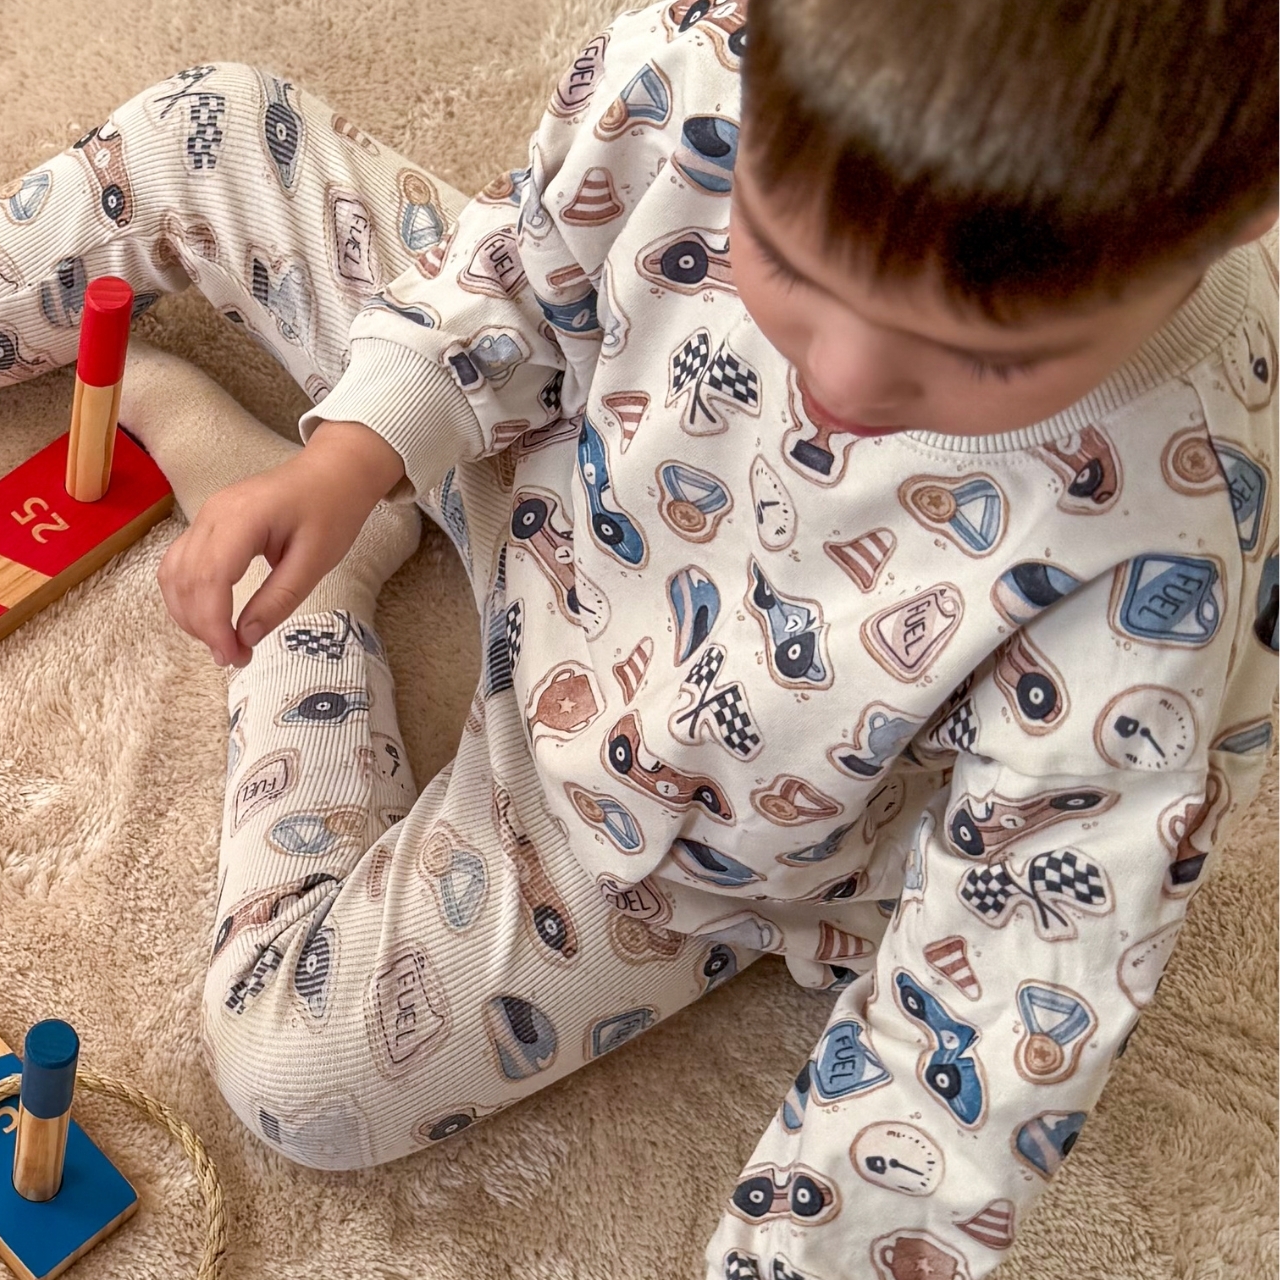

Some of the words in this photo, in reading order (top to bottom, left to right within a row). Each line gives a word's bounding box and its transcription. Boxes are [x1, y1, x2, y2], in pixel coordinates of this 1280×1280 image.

[569, 45, 599, 96] FUEL
[343, 212, 368, 266] FUEL
[484, 237, 515, 283] FUEL
[10, 496, 70, 544] 25
[1138, 572, 1202, 621] FUEL
[903, 599, 931, 657] FUEL
[242, 776, 277, 803] FUEL
[393, 966, 416, 1047] FUEL
[829, 1035, 856, 1085] FUEL
